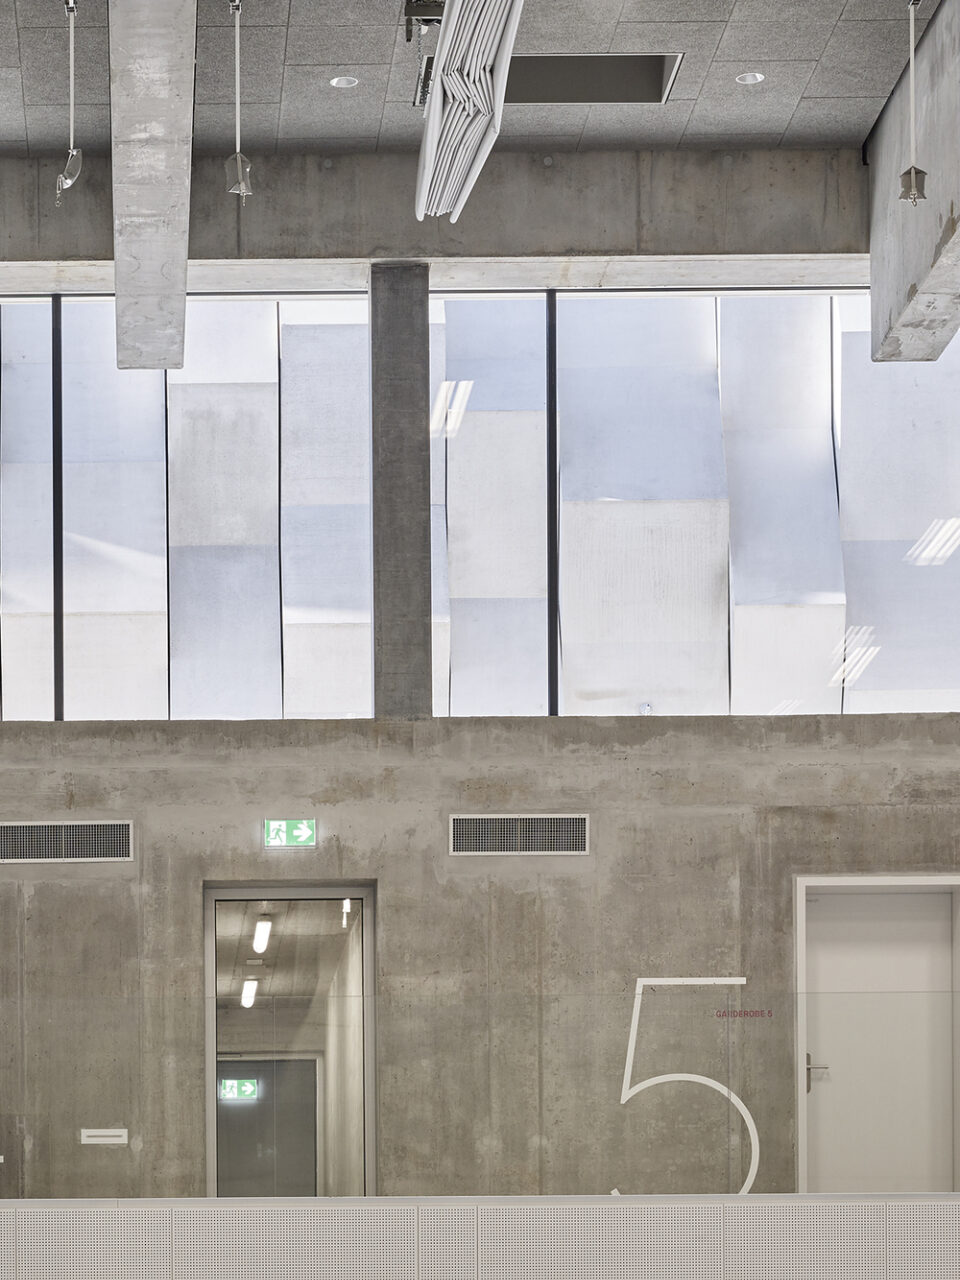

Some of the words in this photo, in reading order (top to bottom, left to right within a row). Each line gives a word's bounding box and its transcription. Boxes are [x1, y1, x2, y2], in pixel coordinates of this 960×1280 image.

[715, 1010, 766, 1018] GARDEROBE
[767, 1010, 773, 1018] 5
[611, 977, 760, 1196] 5
